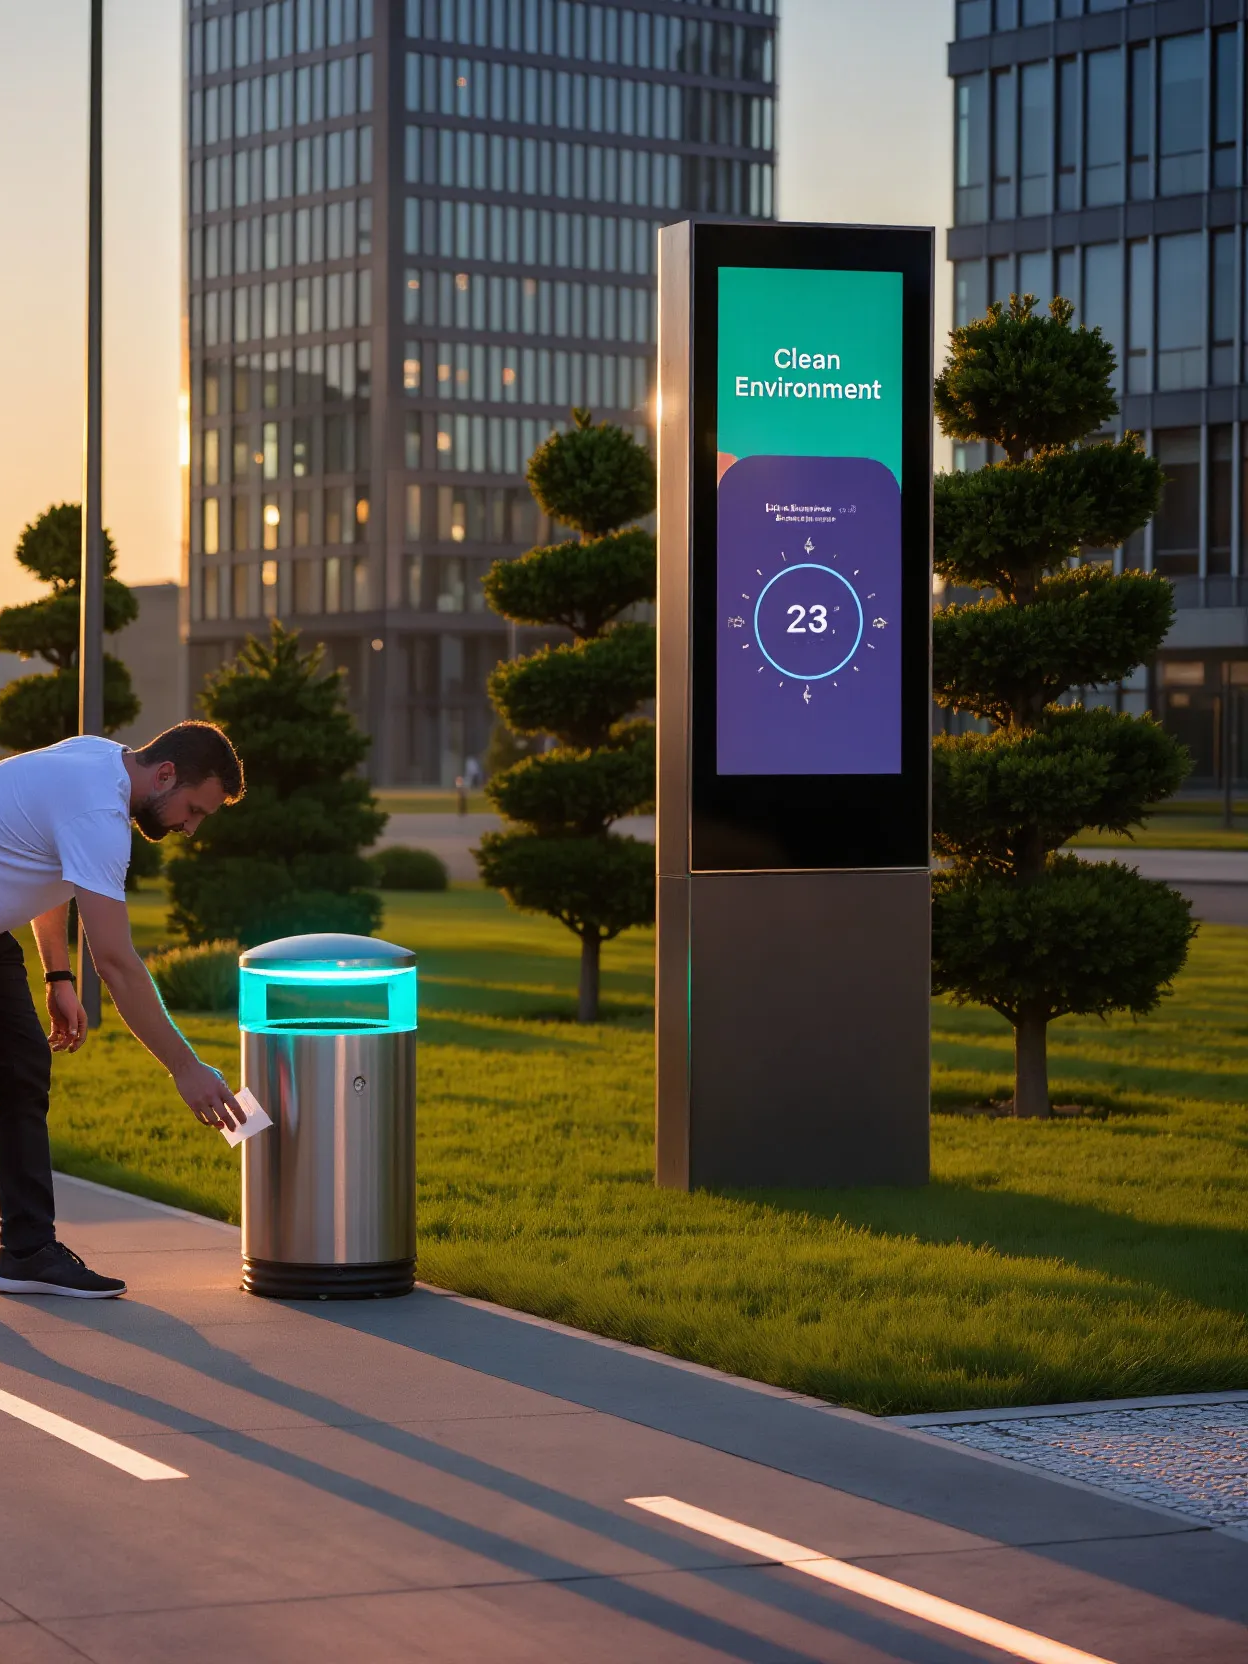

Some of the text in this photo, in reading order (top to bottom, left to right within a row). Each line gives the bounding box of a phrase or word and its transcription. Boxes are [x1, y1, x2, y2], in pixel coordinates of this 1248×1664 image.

[774, 347, 841, 370] Clean
[735, 376, 882, 400] Environment
[786, 604, 828, 634] 23
